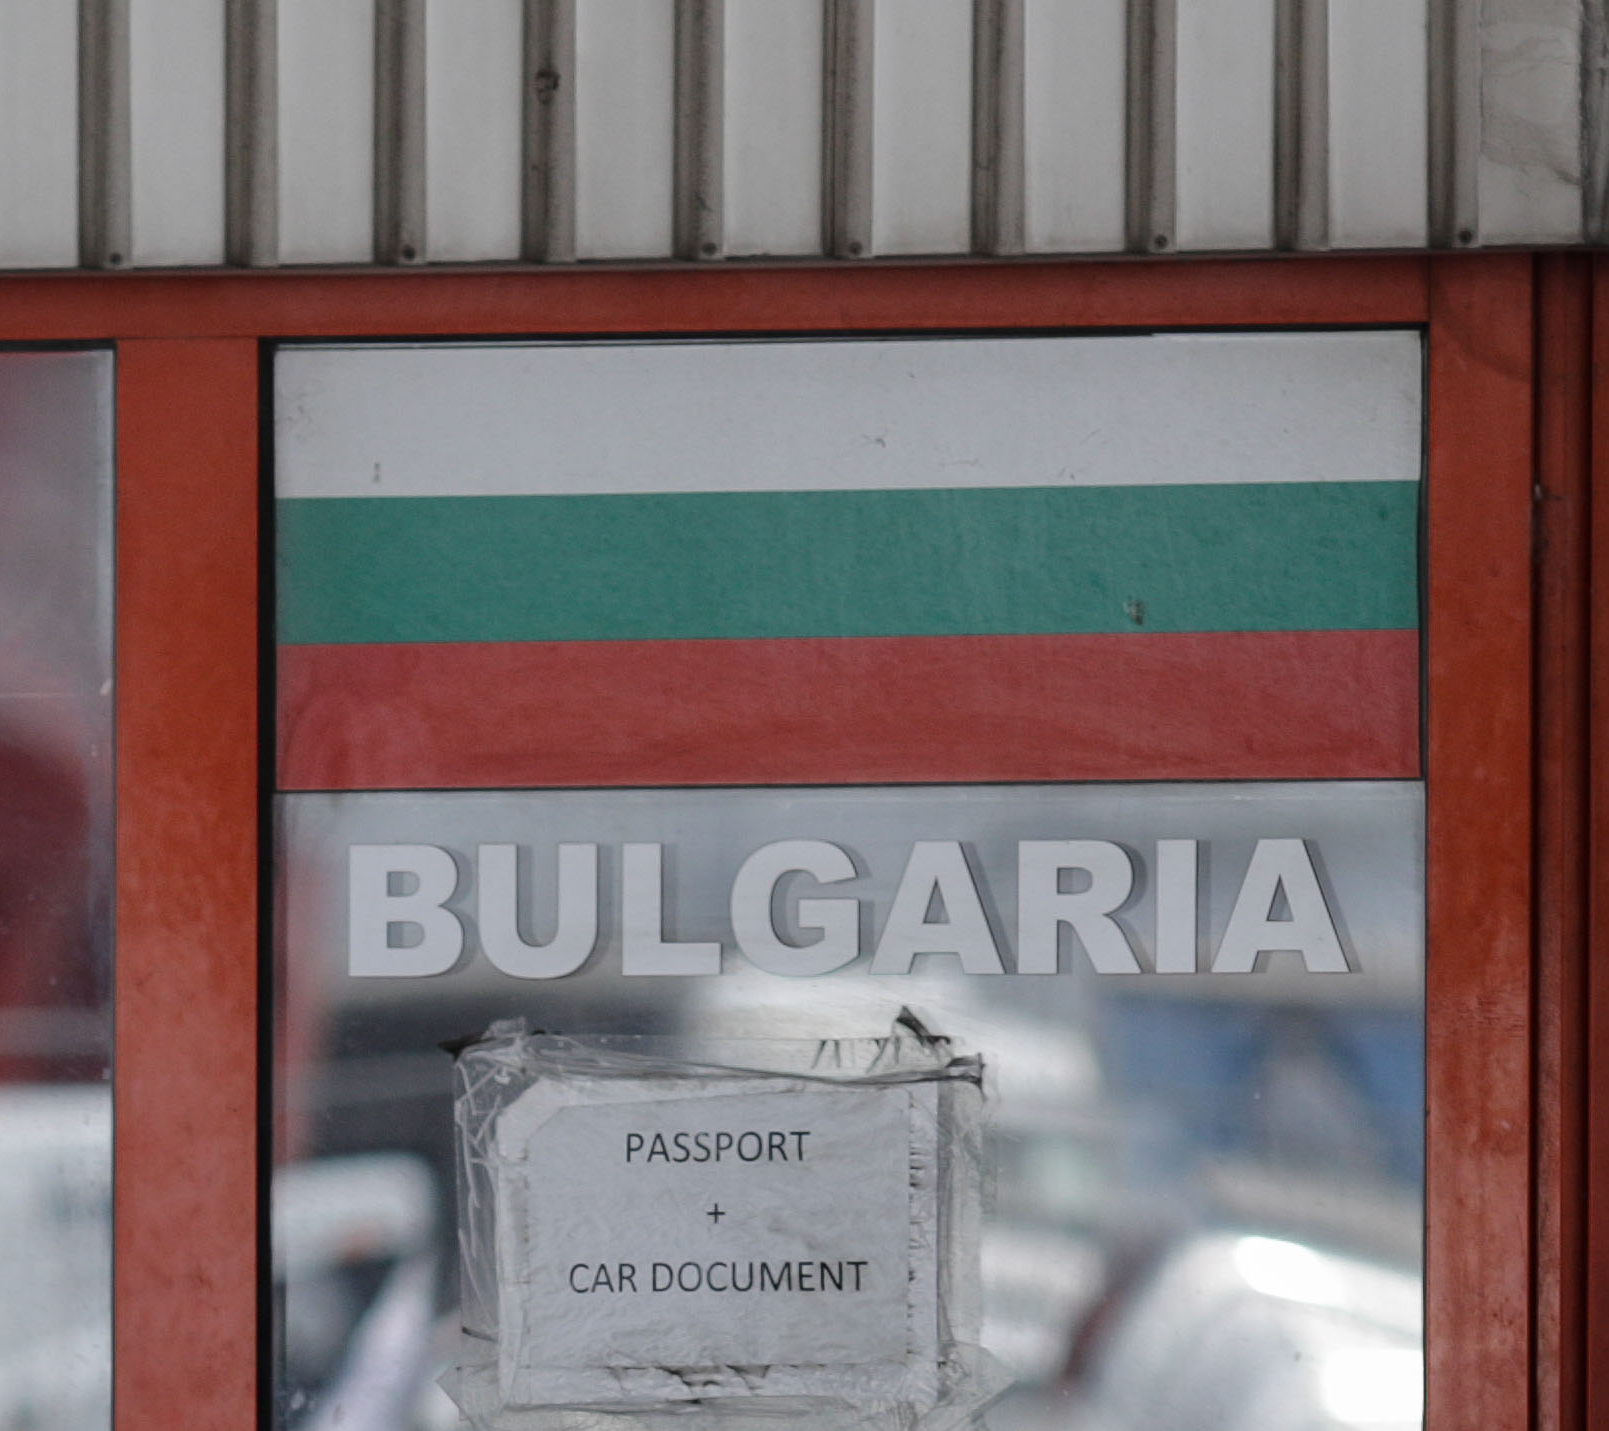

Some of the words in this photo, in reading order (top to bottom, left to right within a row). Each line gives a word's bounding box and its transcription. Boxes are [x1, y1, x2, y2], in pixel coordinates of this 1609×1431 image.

[347, 839, 1353, 979] BULGARIA
[625, 1130, 811, 1164] PASSPORT
[707, 1203, 726, 1225] +
[569, 1262, 638, 1294] CAR
[651, 1260, 869, 1293] DOCUMENT
